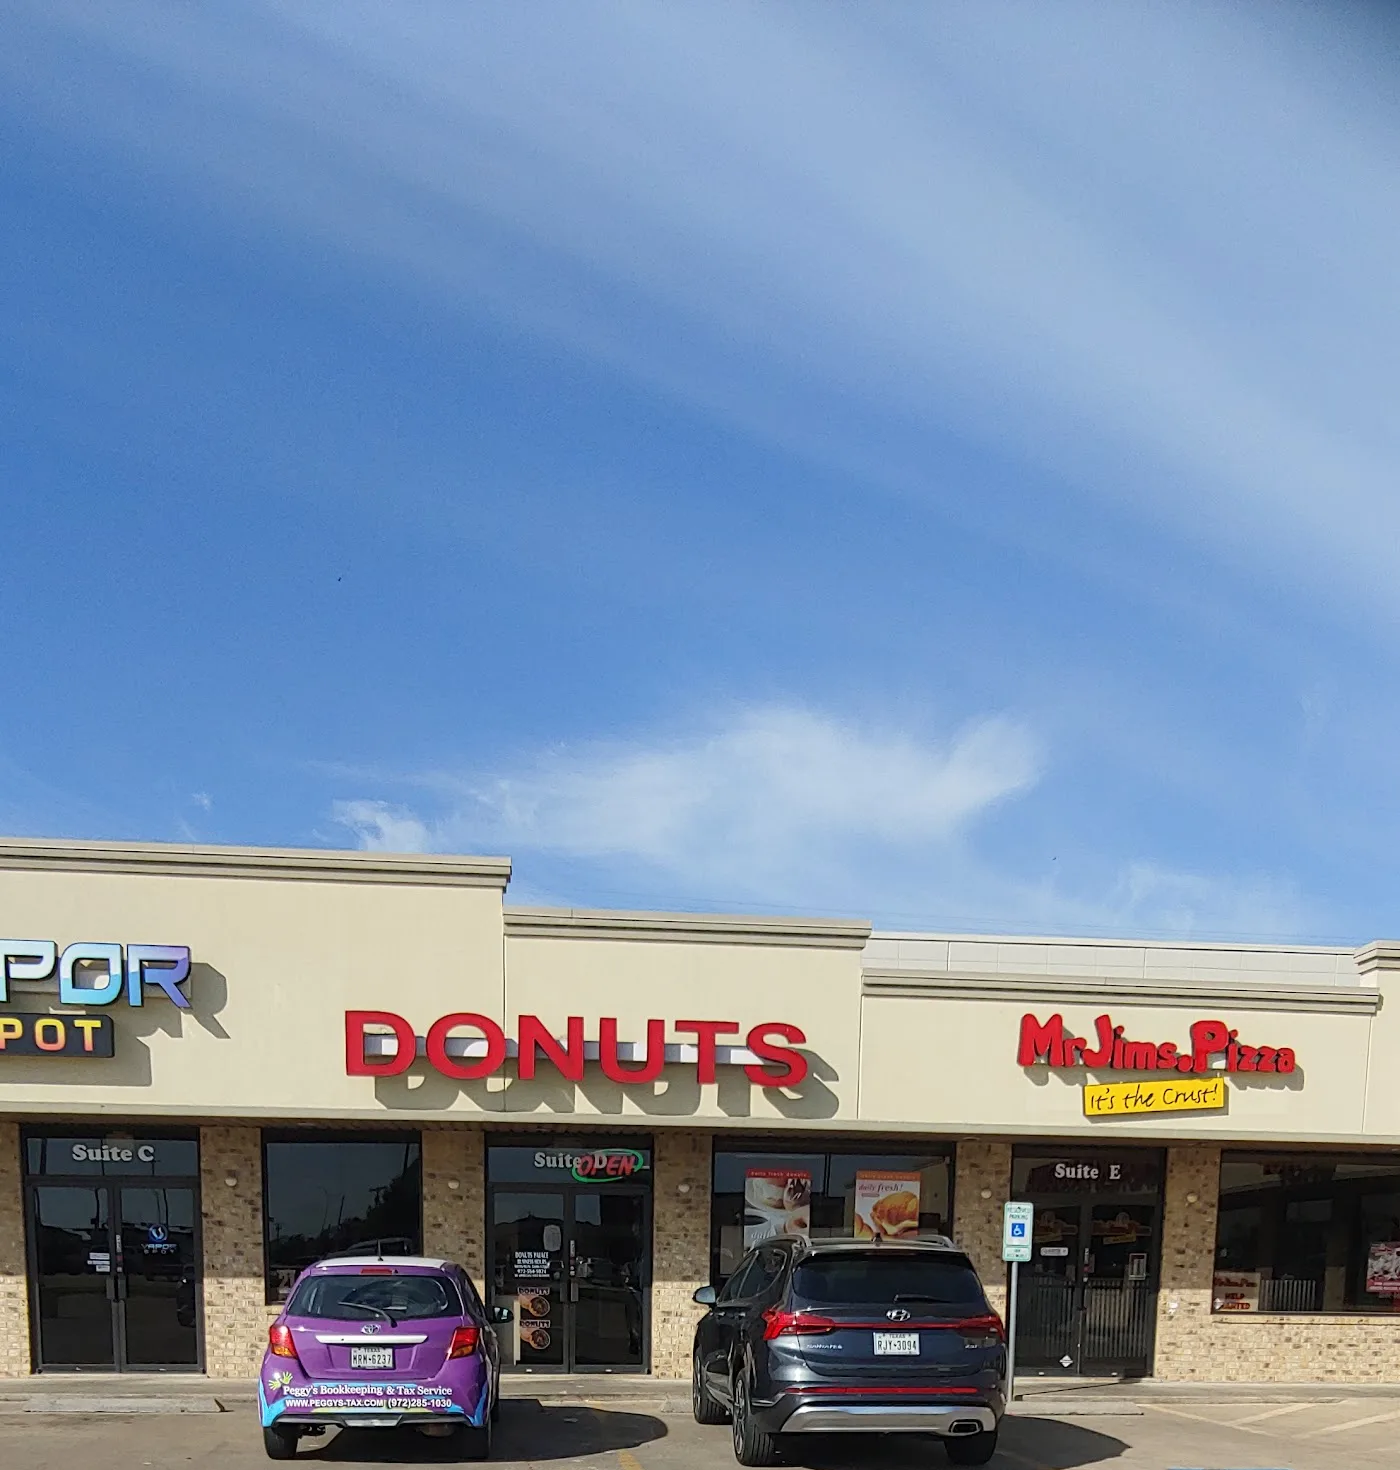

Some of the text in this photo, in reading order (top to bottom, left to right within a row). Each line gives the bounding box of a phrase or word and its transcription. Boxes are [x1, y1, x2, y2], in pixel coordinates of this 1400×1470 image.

[344, 1009, 809, 1087] DONUTS
[1090, 1083, 1219, 1110] It's the Crust!
[72, 1144, 155, 1162] Suite C
[534, 1152, 581, 1168] Suite
[1054, 1163, 1121, 1180] Suite E
[283, 1384, 452, 1397] Peggy's Bookkeeping & Tax Service
[388, 1398, 452, 1408] (972)285-1030
